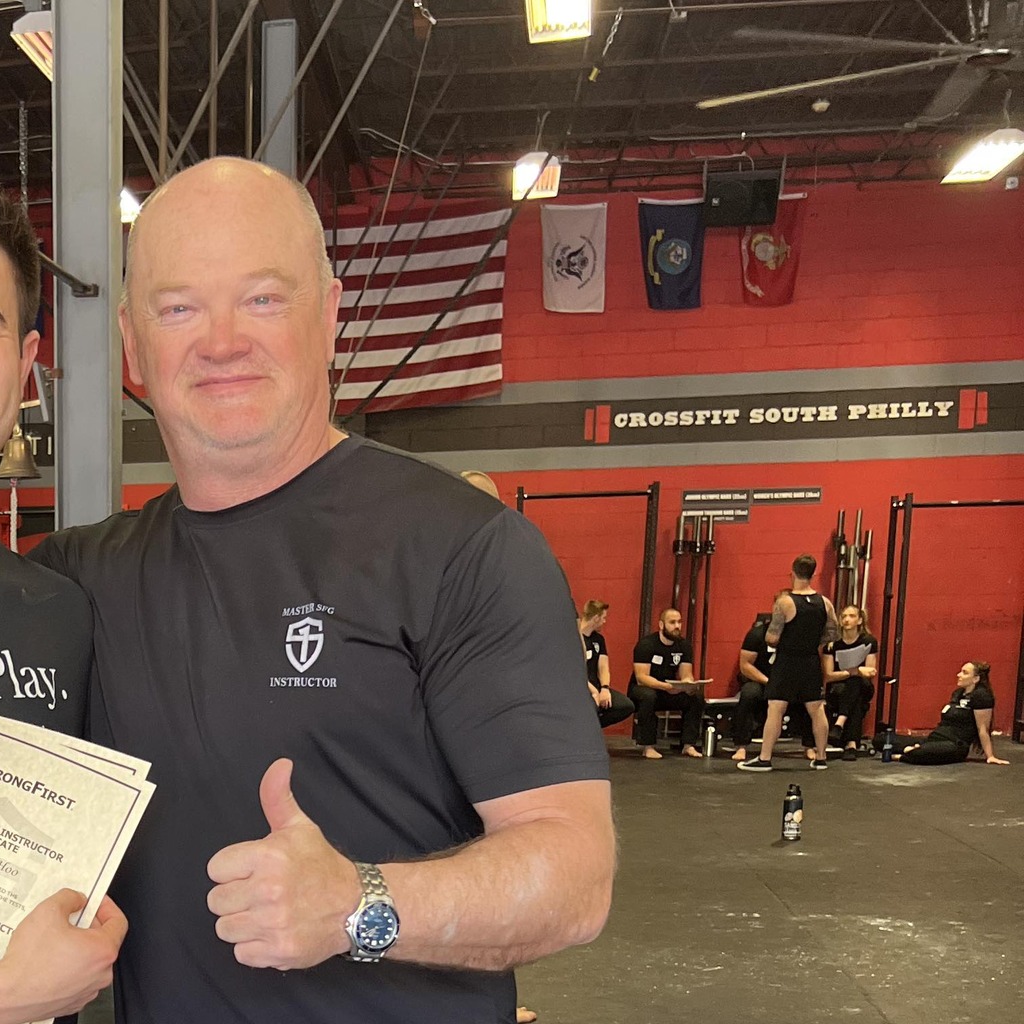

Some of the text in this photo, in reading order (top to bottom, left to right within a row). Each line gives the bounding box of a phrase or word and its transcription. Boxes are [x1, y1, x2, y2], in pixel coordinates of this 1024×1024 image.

[614, 401, 955, 429] CROSSFIT SOUTH PHILLY
[282, 602, 335, 617] MASTER SFG
[269, 677, 337, 688] INSTRUCTOR
[0, 828, 64, 863] INSTRUCTOR
[7, 890, 18, 900] THE
